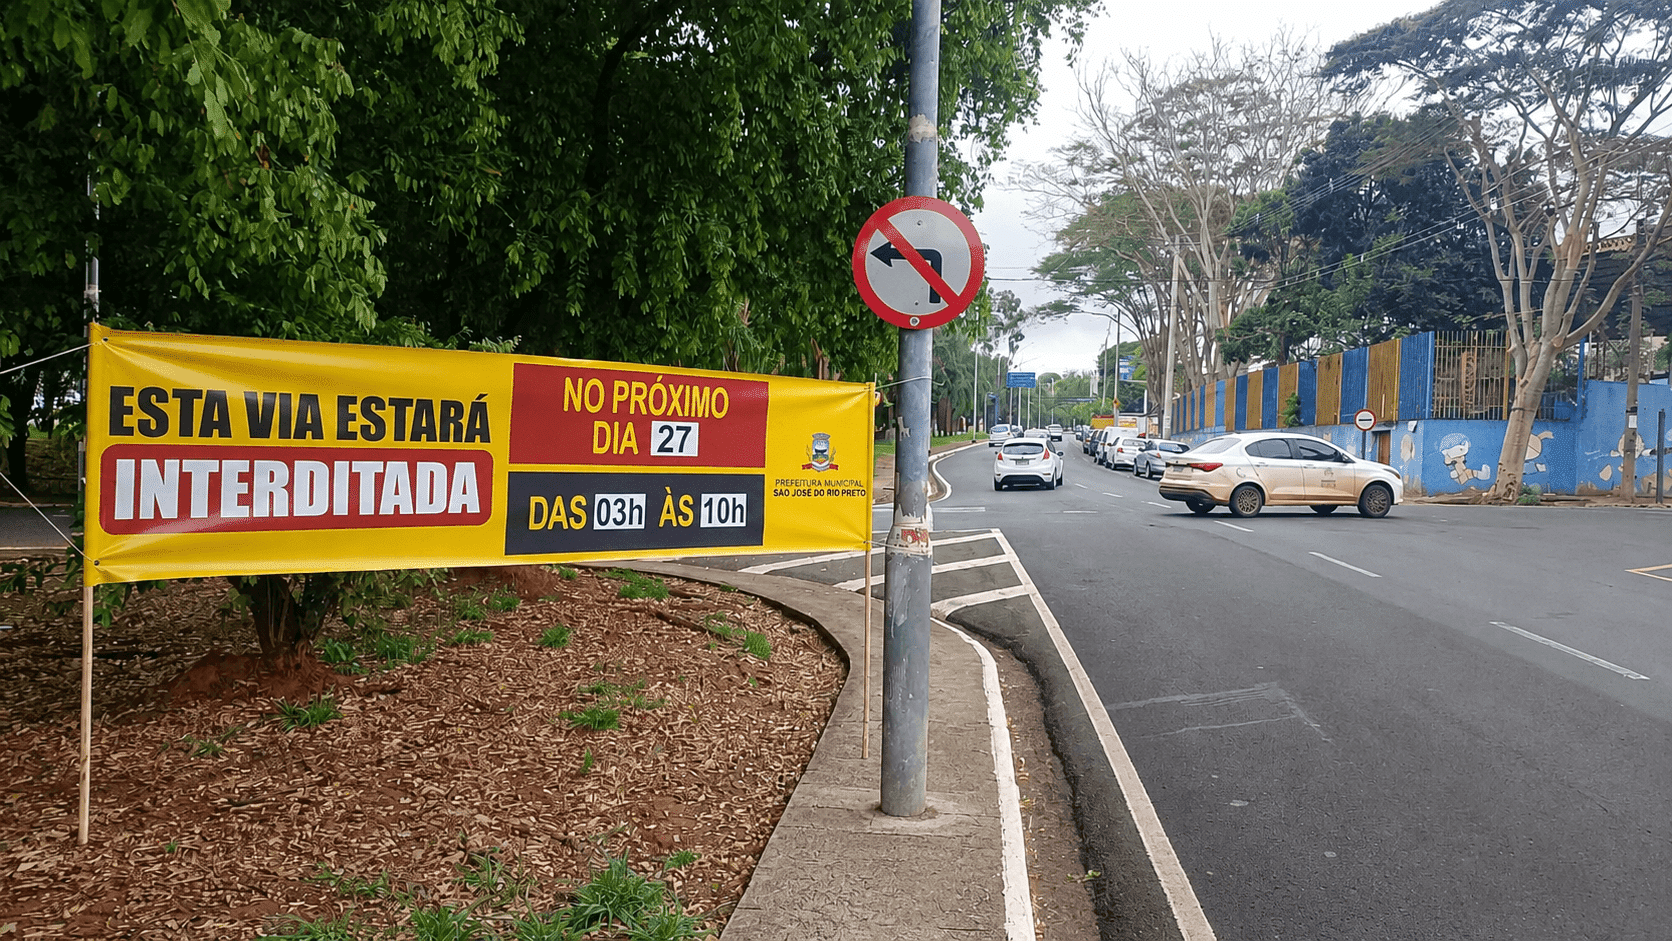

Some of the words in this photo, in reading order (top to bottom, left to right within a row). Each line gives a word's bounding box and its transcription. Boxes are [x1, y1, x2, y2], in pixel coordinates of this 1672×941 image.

[108, 385, 232, 439] ESTA
[243, 391, 324, 440] VIA
[335, 392, 491, 443] ESTARÁ
[563, 377, 605, 413] NO
[612, 375, 729, 419] PRÓXIMO
[592, 420, 639, 455] DIA
[656, 424, 692, 453] 27
[113, 458, 481, 521] INTERDITADA
[775, 479, 822, 487] PREFEITURA
[824, 480, 864, 488] MUNICIPAL
[813, 488, 825, 497] DO
[826, 488, 840, 497] RIO
[841, 488, 866, 497] PRETO
[529, 496, 587, 530] DAS
[597, 497, 643, 527] 03h
[658, 486, 694, 527] ÀS
[703, 497, 745, 524] 10h
